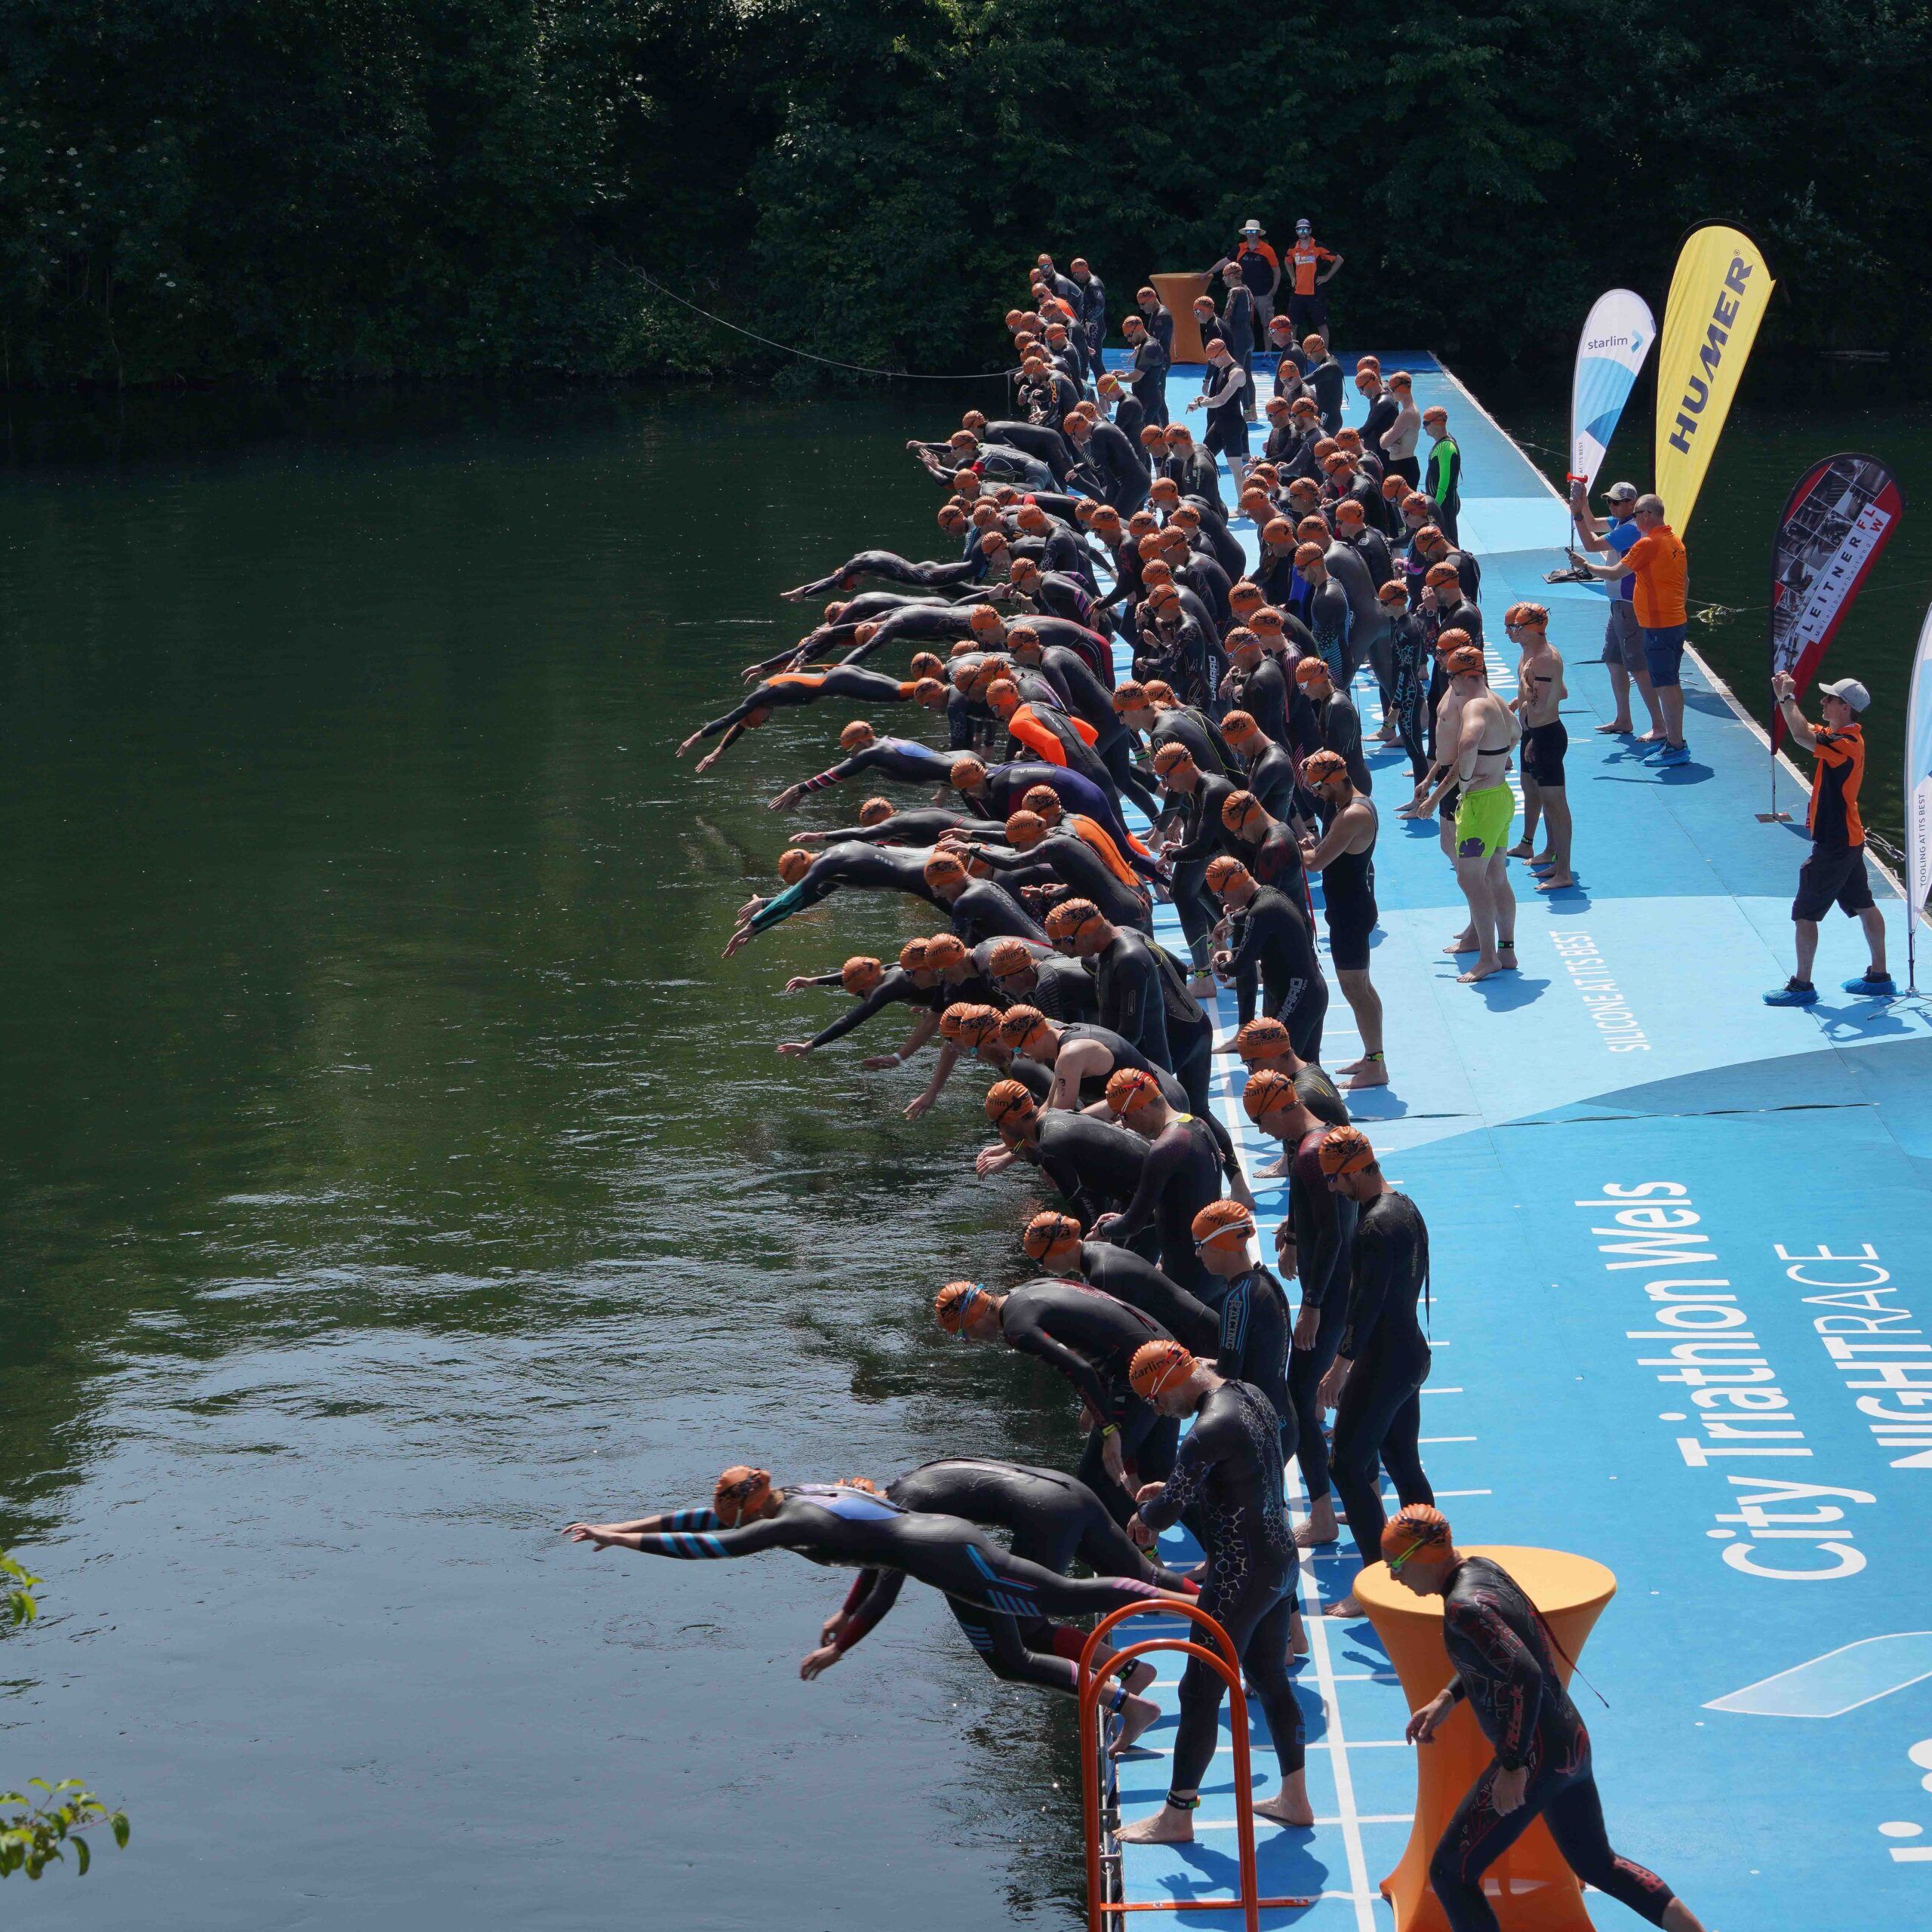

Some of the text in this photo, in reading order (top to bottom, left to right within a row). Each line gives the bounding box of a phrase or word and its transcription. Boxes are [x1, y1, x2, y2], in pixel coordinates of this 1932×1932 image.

[1588, 336, 1628, 349] starlim
[1669, 257, 1753, 454] HUMER
[1801, 536, 1862, 633] LEITNER
[1209, 655, 1217, 701] CAMARO
[1007, 821, 1034, 832] starlim
[1919, 833, 1926, 844] AT
[926, 945, 952, 958] starlim
[991, 950, 1019, 964] starlim
[1549, 931, 1652, 1052] SILICONE AT ITS BEST
[1225, 1300, 1242, 1350] RACING
[1574, 1181, 1877, 1580] City Triathlon Wels
